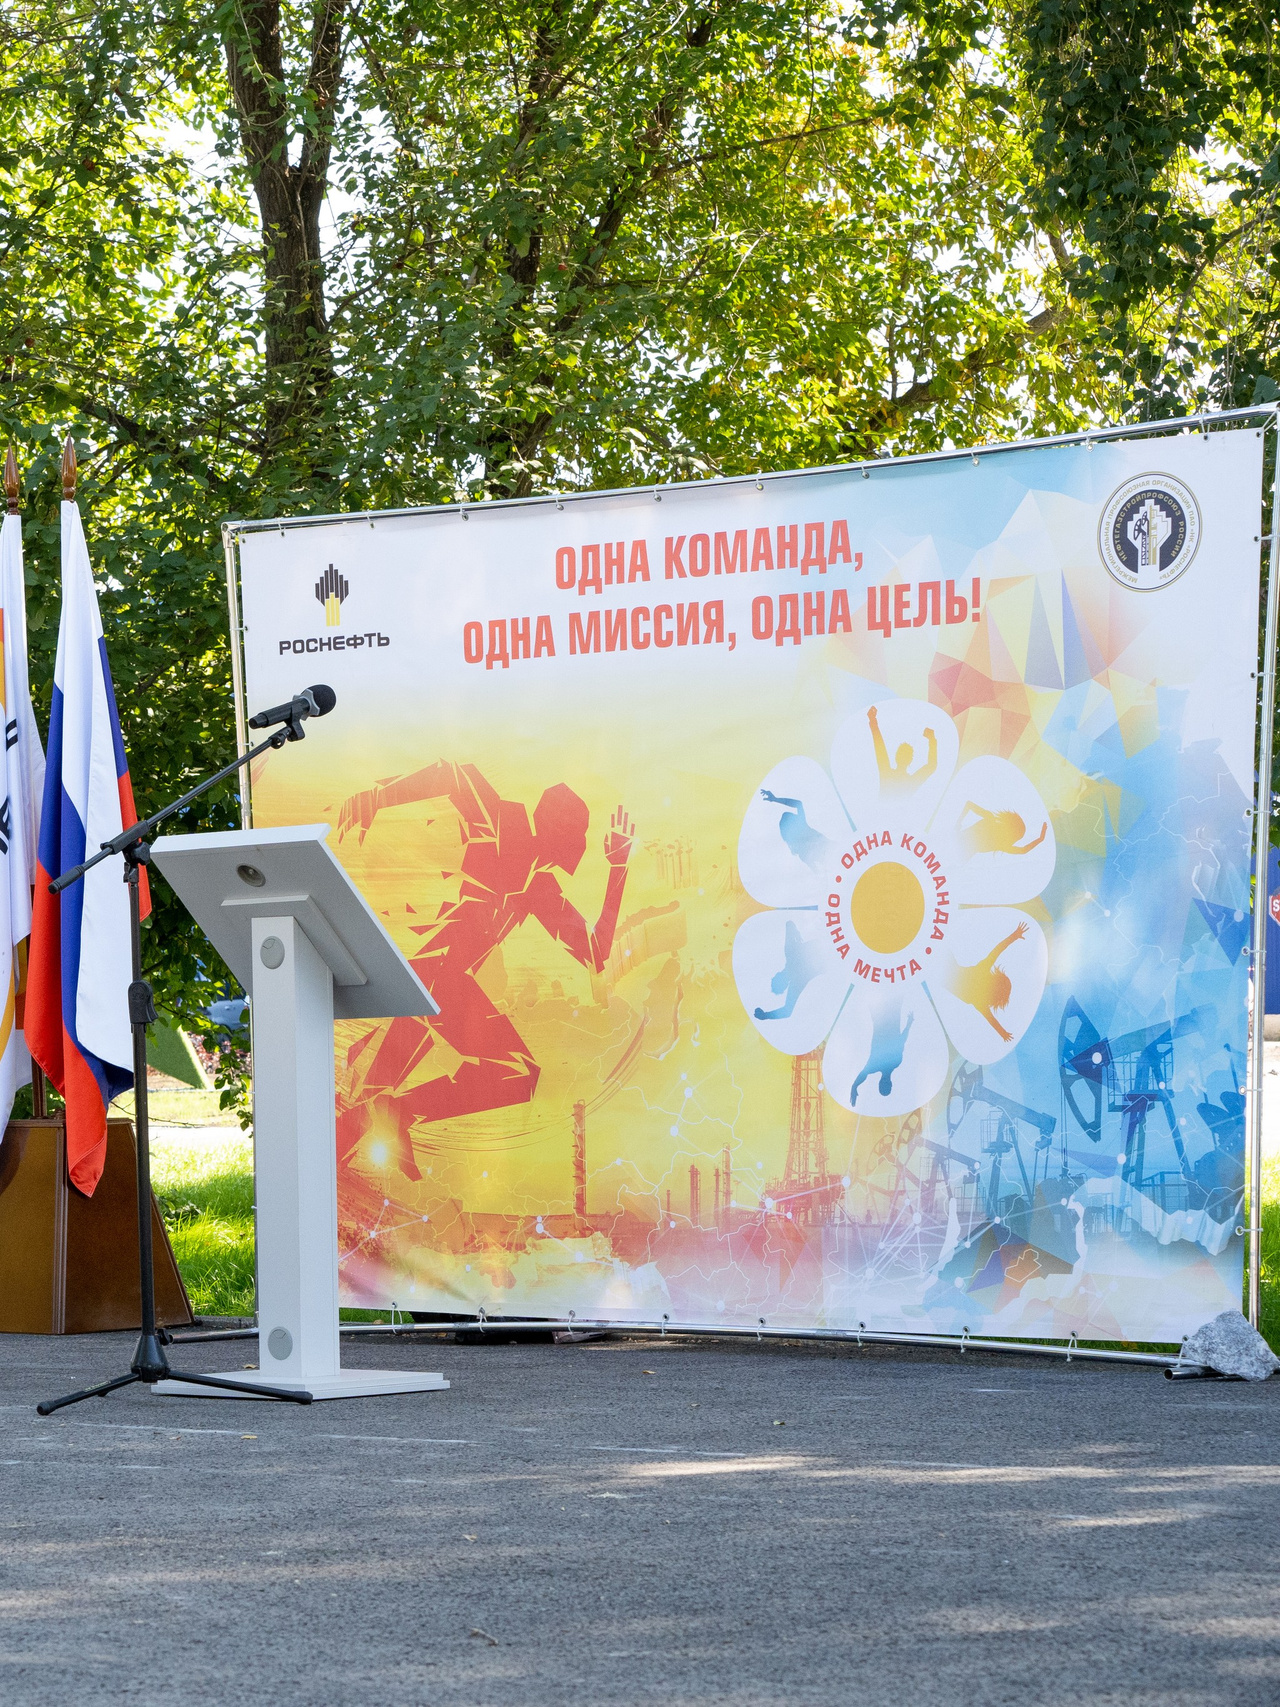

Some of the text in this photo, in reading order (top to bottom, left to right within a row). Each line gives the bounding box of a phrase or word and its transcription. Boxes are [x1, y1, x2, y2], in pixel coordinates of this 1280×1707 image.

[1109, 480, 1151, 520] ПРОФСОЮЗНАЯ
[1114, 491, 1185, 562] НЕФТЕГАЗСТРОЙПРОФСОЮЗ РОССИИ
[1151, 480, 1192, 511] ОРГАНИЗАЦИЯ
[1188, 510, 1196, 527] ПАО
[555, 519, 863, 596] ОДНА КОМАНДА,
[1104, 521, 1138, 584] МЕЖРЕГИОНАЛЬНАЯ
[279, 632, 391, 656] РОСНЕФТЬ
[463, 577, 981, 670] ОДНА МИССИЯ, ОДНА ЦЕЛЬ!
[840, 830, 950, 941] ОДНА КОМАНДА
[824, 893, 923, 984] ОДНА МЕЧТА
